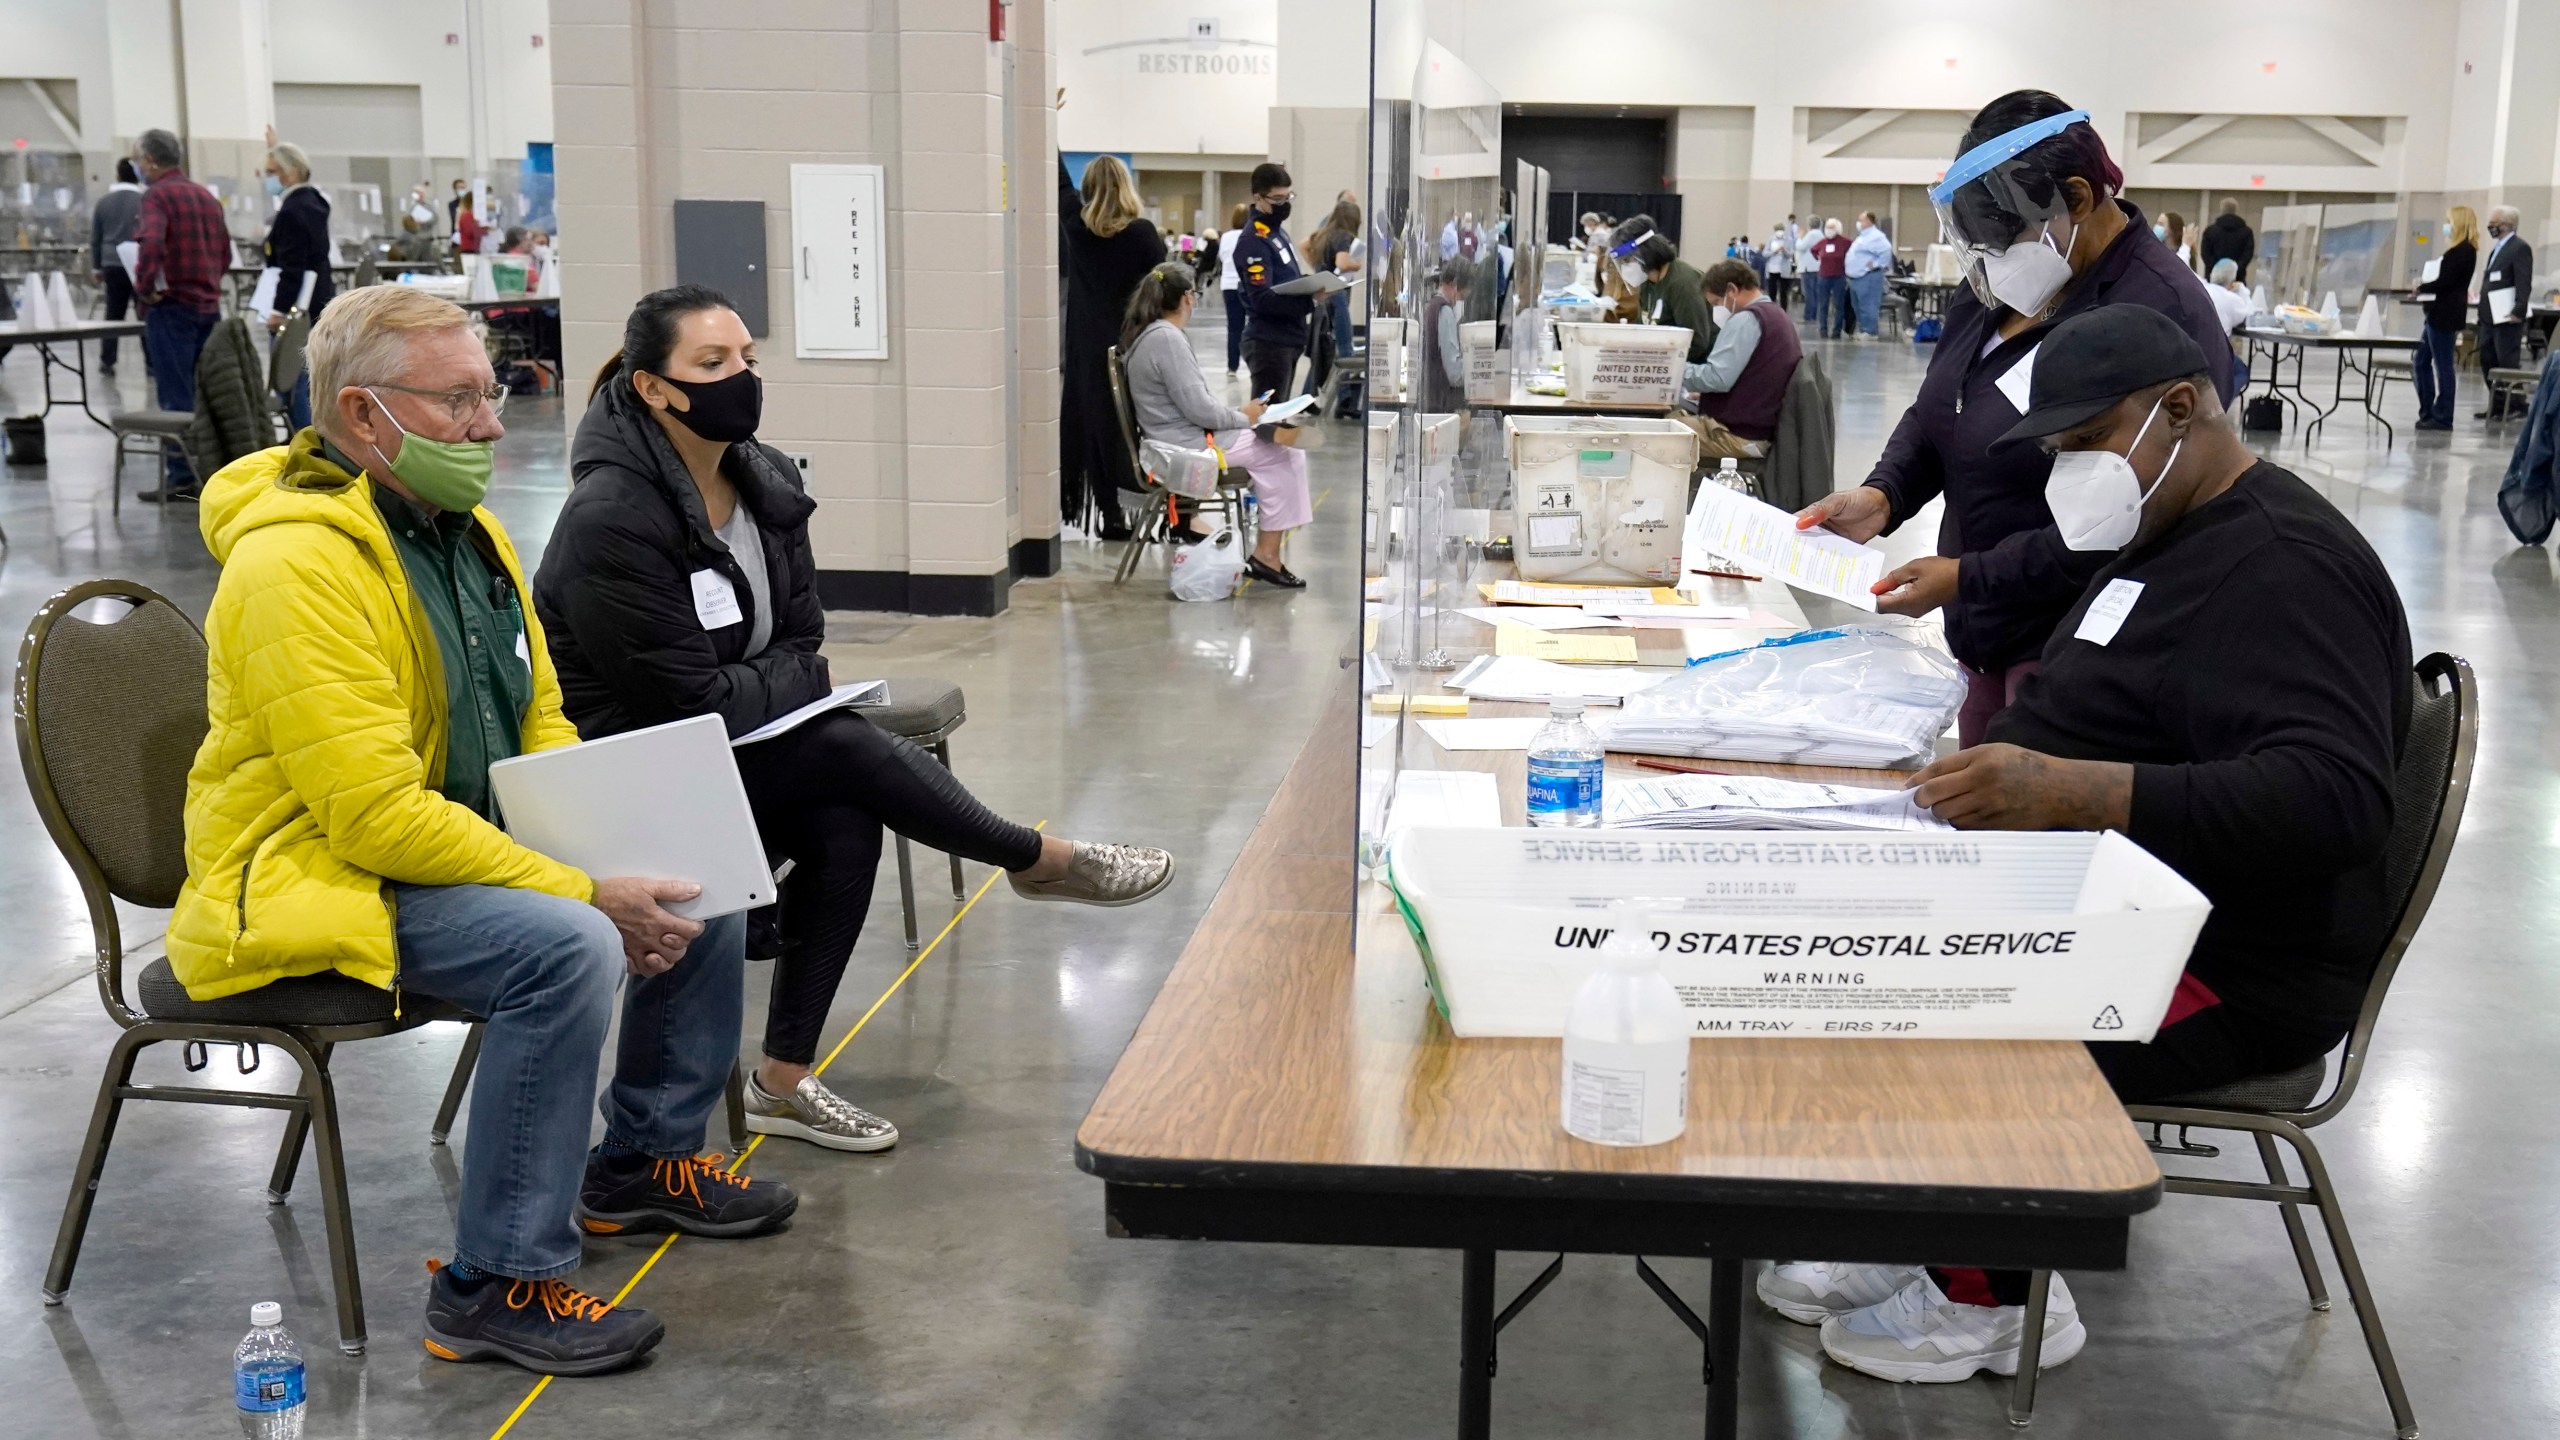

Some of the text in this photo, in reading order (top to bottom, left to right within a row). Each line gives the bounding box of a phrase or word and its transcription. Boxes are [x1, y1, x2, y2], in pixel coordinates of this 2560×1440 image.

[1138, 53, 1271, 75] RESTROOMS
[1596, 364, 1669, 374] UNITED STATES
[1592, 375, 1673, 385] POSTAL SERVICE
[1555, 926, 2076, 956] UNID STATES POSTAL SERVICE
[1763, 972, 1866, 985] WARNING
[1696, 1020, 1732, 1031] MM
[1739, 1021, 1794, 1031] TRAY
[1824, 1021, 1873, 1031] EIRS
[1879, 1022, 1918, 1032] 74P
